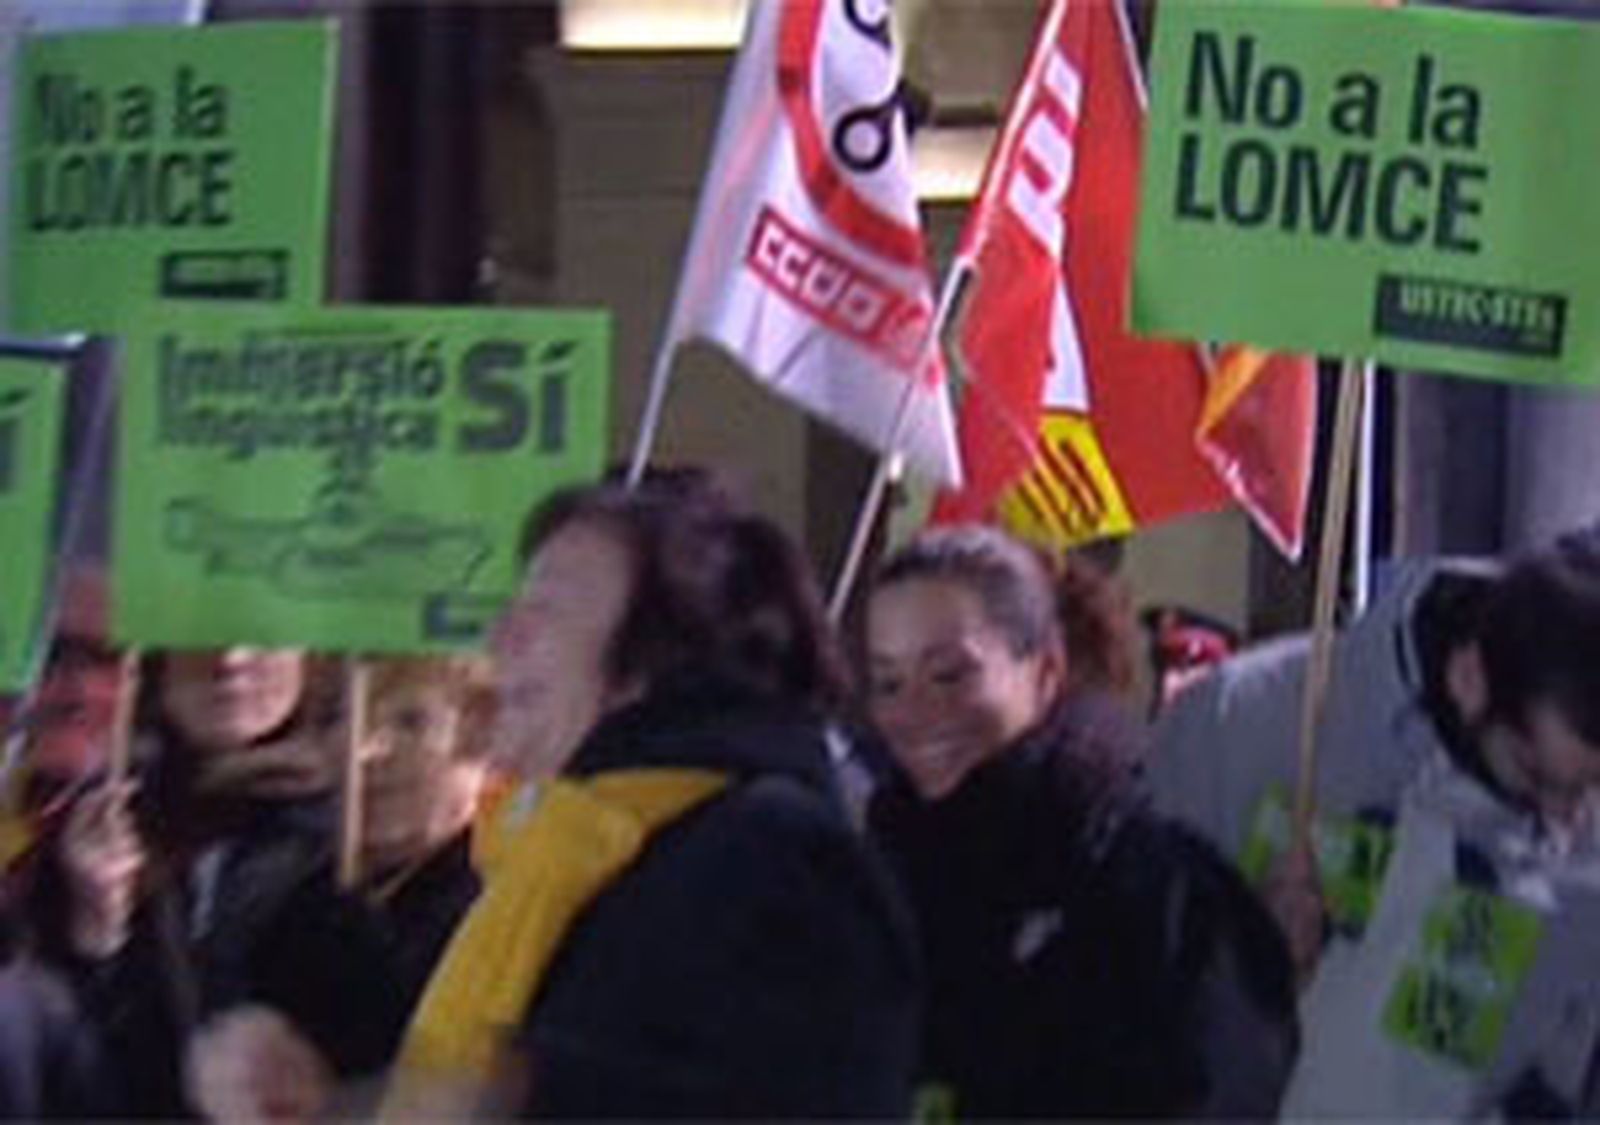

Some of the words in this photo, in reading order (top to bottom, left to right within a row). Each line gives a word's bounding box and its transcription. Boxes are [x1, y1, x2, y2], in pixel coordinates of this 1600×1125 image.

[35, 74, 100, 146] No
[117, 85, 154, 143] a
[173, 64, 228, 141] la
[1185, 31, 1304, 129] No
[1329, 72, 1381, 140] a
[1408, 54, 1481, 150] la
[28, 150, 237, 233] LOMCE
[1174, 133, 1489, 255] LOMCE
[456, 338, 577, 456] Sí
